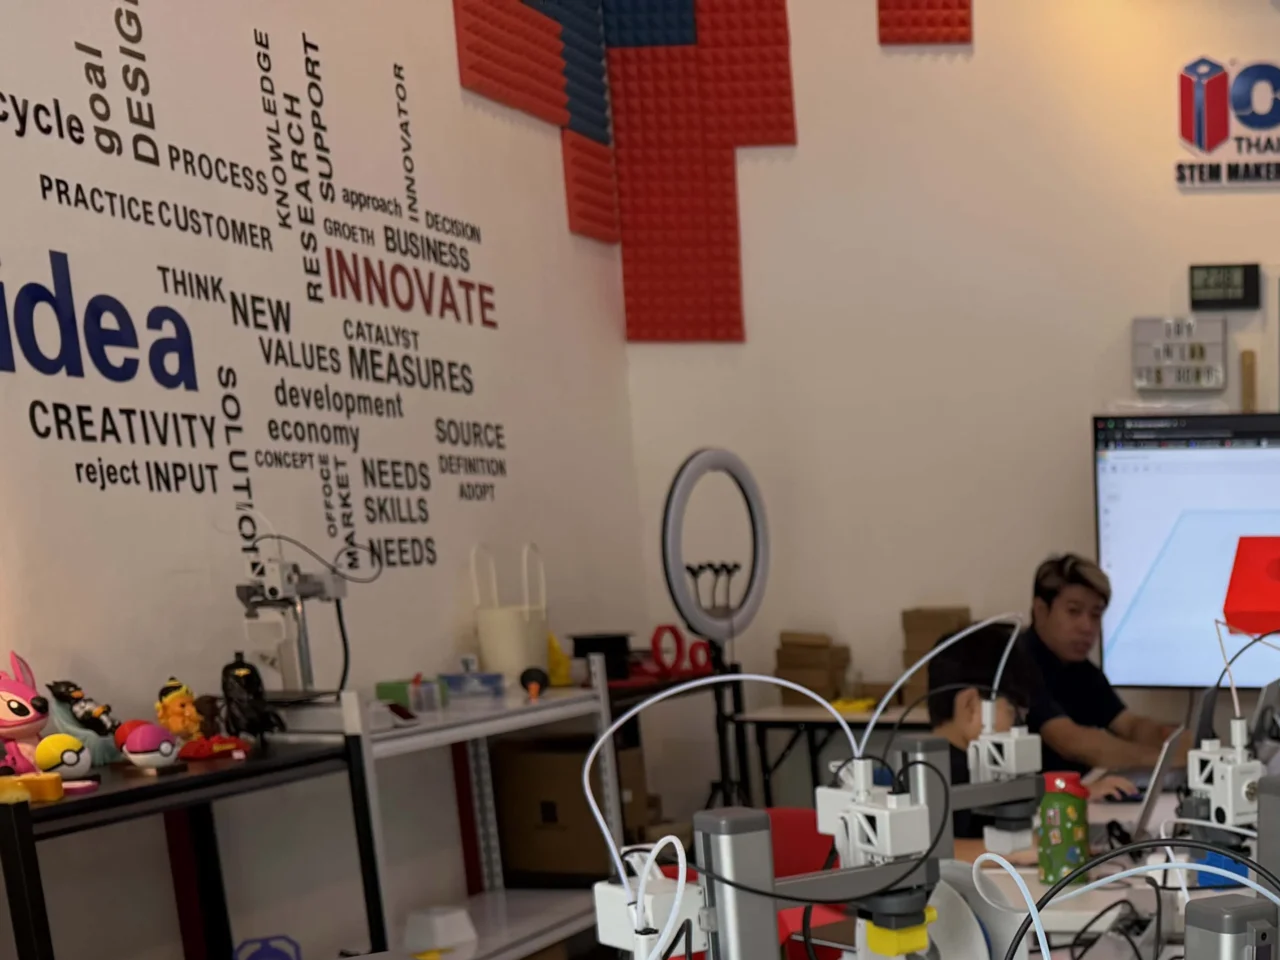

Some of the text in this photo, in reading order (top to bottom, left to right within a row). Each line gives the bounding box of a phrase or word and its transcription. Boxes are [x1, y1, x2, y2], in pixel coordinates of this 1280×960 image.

[74, 41, 123, 157] goal
[113, 0, 160, 167] DESIG
[253, 28, 292, 230] KNOWLEDGE
[301, 32, 336, 204] SUPPORT
[393, 63, 420, 223] INNOVATOR
[168, 145, 269, 195] PROCESS
[1176, 162, 1221, 184] STEM
[40, 174, 274, 253] PRACTICE CUSTOMER
[283, 92, 324, 304] RESEARCH
[341, 188, 403, 219] approach
[323, 217, 471, 273] GROETH BUSINESS
[425, 210, 482, 245] DECISION
[157, 265, 292, 335] THINK NEW
[324, 246, 498, 329] INNOVATE
[343, 318, 420, 352] CATALYST
[259, 336, 475, 396] VALUES MEASURES
[274, 378, 405, 420] development
[29, 400, 217, 449] CREATIVITY
[268, 419, 361, 454] economy
[435, 416, 506, 450] SOURCE
[75, 456, 219, 495] reject INPUT
[255, 449, 315, 471] CONCEPT
[361, 456, 432, 491] NEEDS
[438, 453, 507, 478] DEFINITION
[334, 455, 360, 570] MARKET
[364, 495, 430, 525] SKILLS
[459, 482, 495, 502] ADOPT
[368, 536, 438, 568] NEEDS
